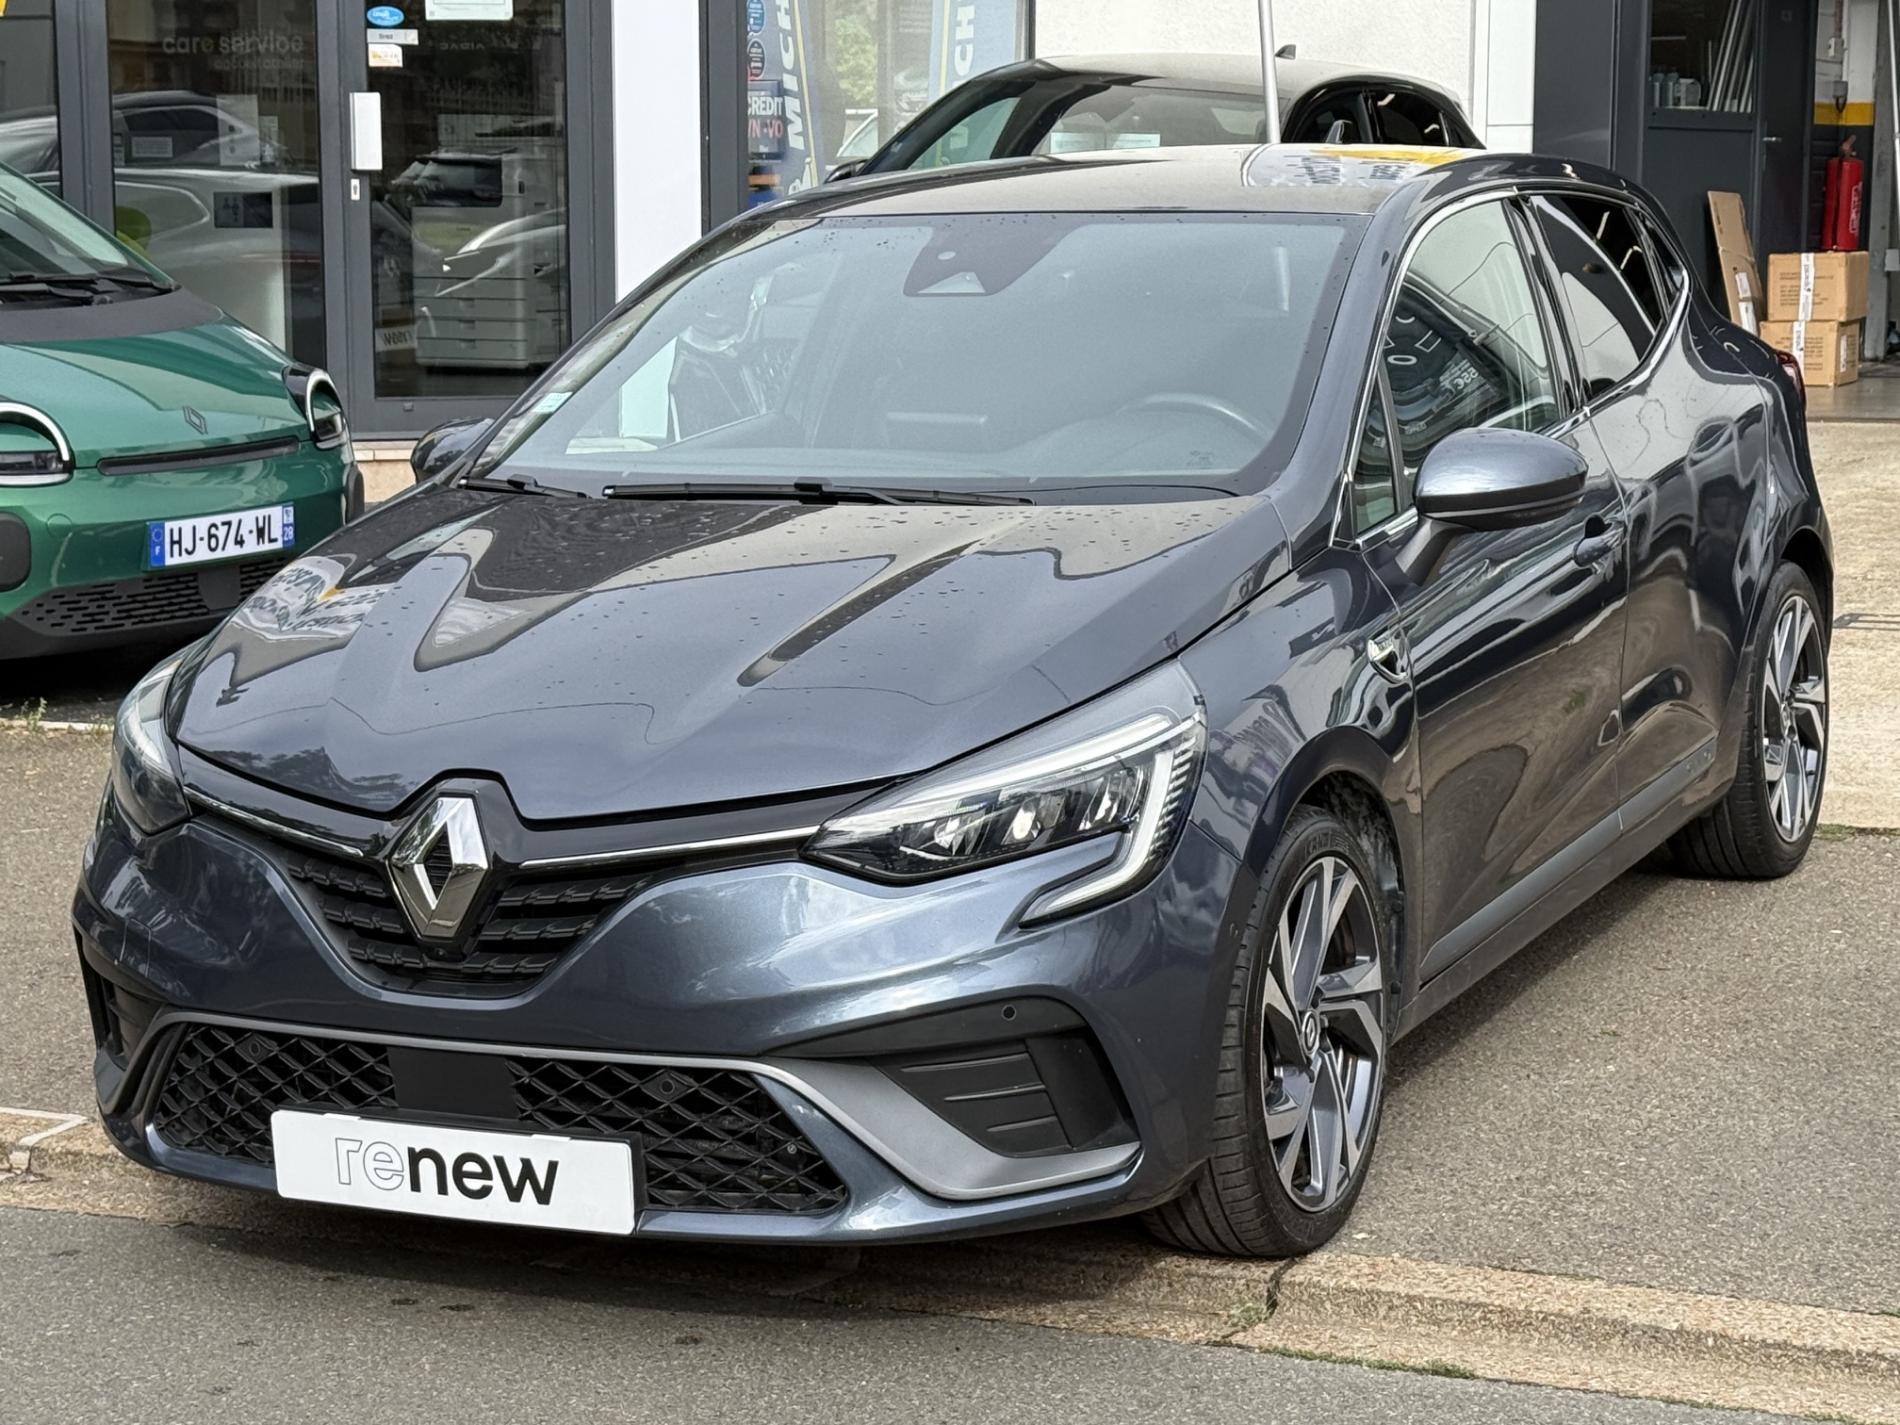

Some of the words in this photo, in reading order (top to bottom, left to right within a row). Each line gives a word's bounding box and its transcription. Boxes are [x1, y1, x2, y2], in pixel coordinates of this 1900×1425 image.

[162, 36, 214, 54] care
[219, 30, 304, 54] service
[169, 514, 278, 558] HJ-674-WL
[334, 1137, 559, 1206] renew
